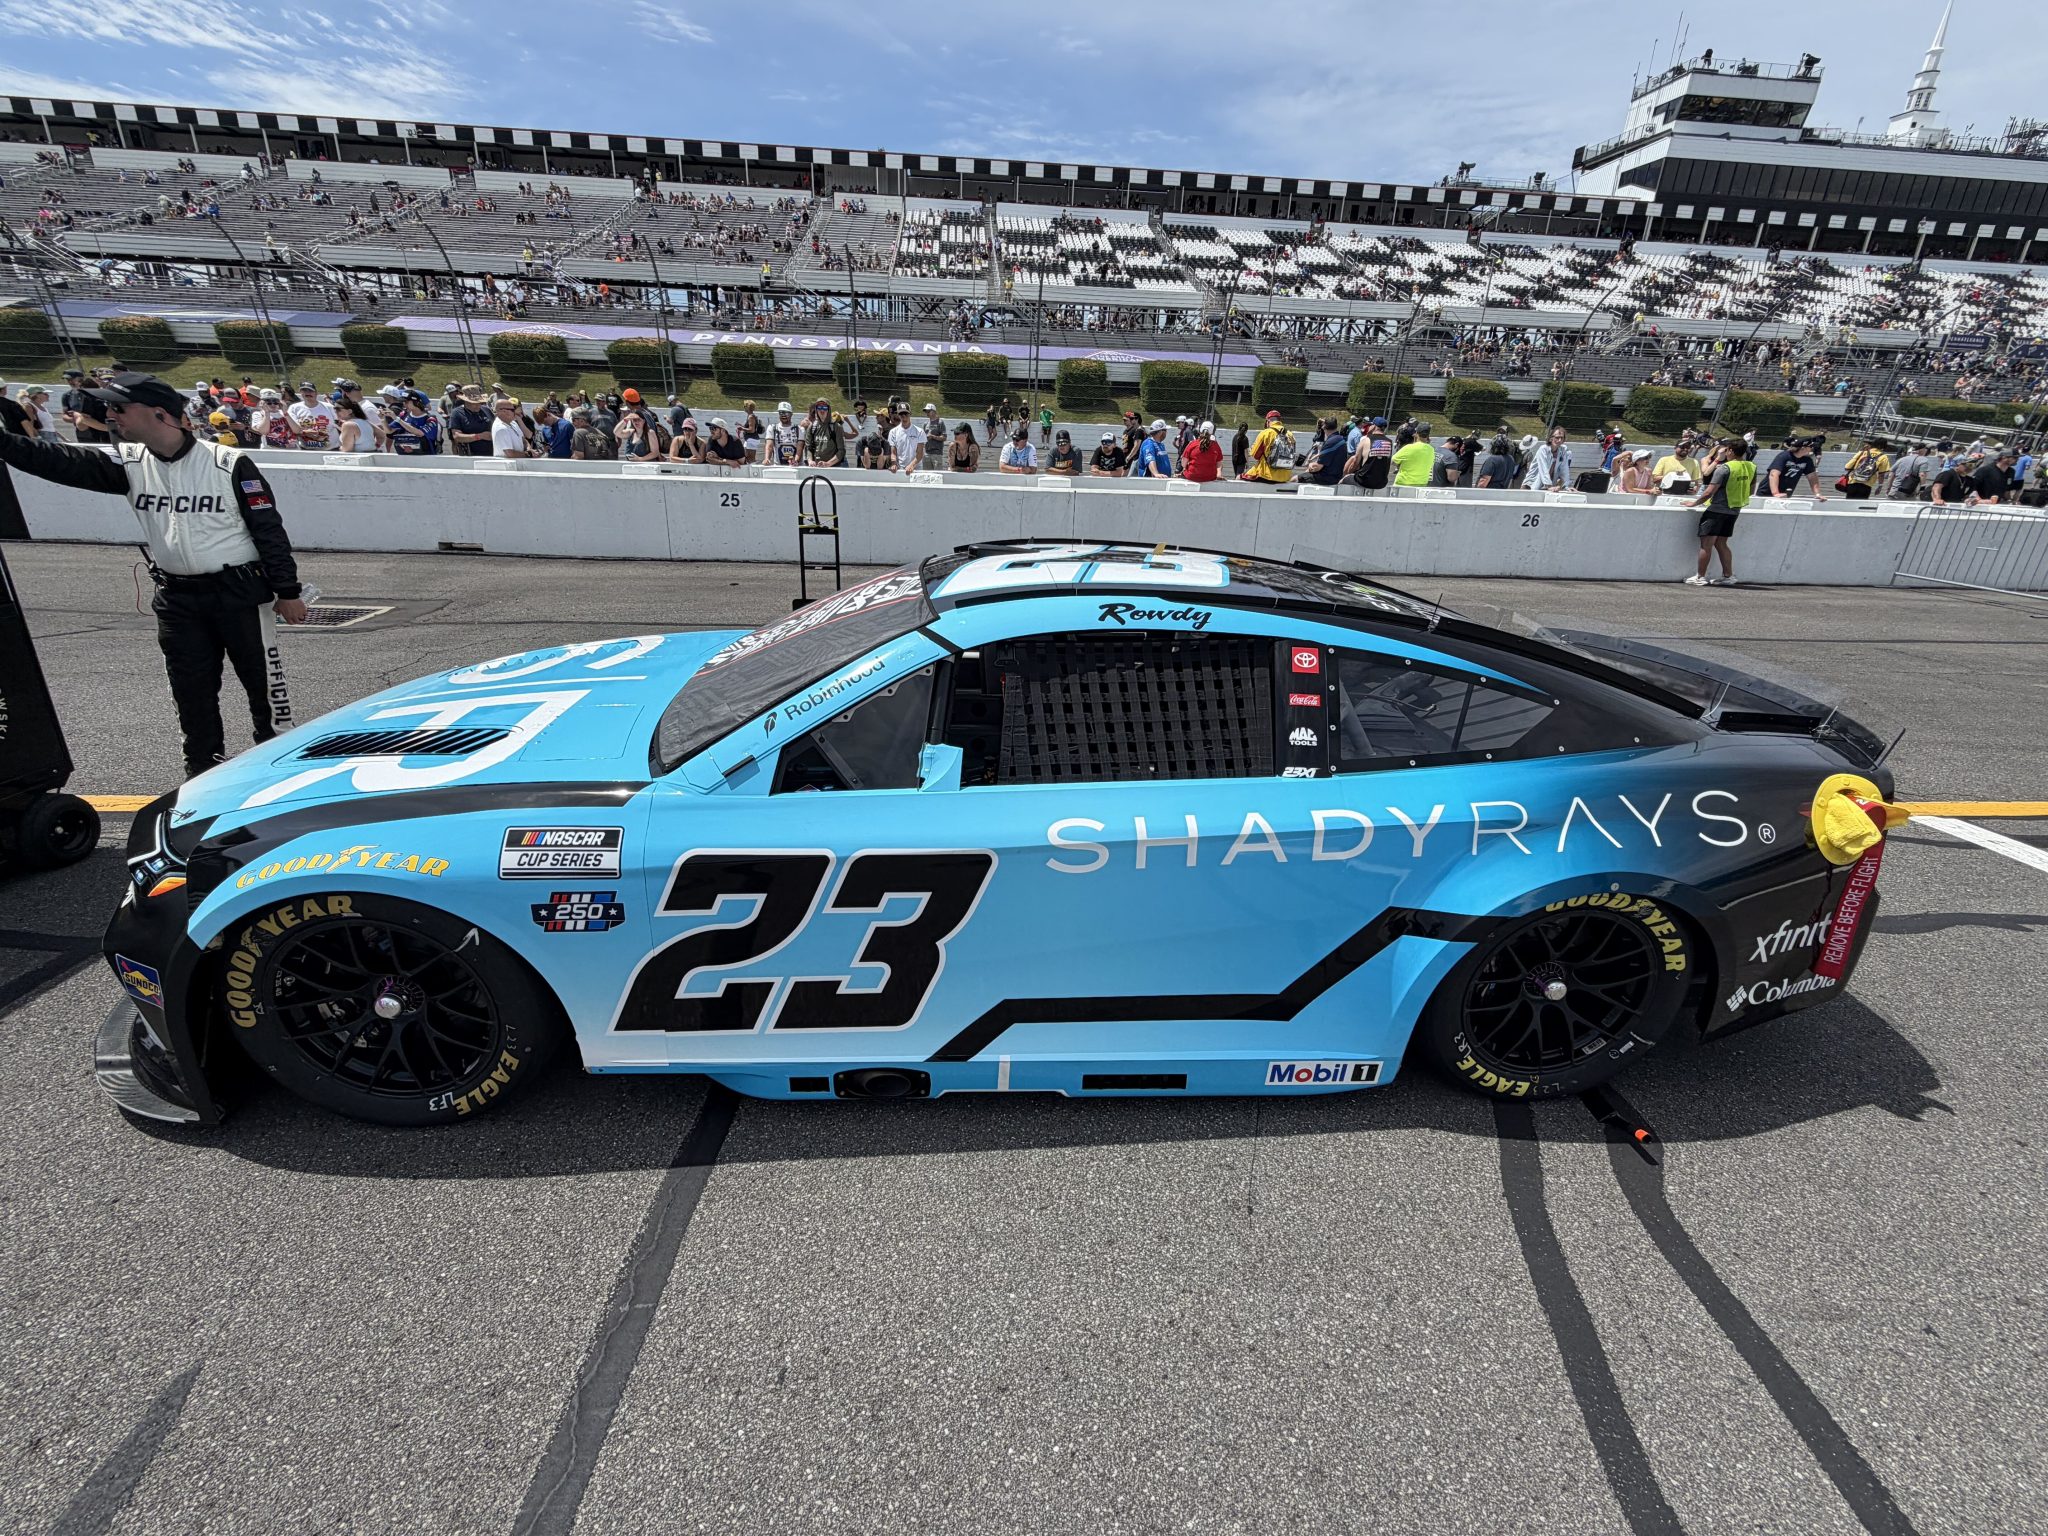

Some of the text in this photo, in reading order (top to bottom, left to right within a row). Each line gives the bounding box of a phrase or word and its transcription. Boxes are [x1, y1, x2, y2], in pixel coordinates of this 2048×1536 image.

[692, 333, 985, 353] PENNSYLVANIA
[135, 493, 226, 513] OFFICIAL
[720, 493, 741, 507] 25
[1521, 513, 1540, 527] 26
[1098, 603, 1213, 629] Rowdy
[267, 647, 292, 725] OFFICIAL
[784, 656, 886, 721] Robinhood
[1288, 727, 1318, 741] MAC
[1282, 767, 1321, 778] 23XI
[541, 831, 606, 846] NASCAR
[517, 853, 604, 867] CUP SERIES
[554, 903, 604, 920] 250
[1823, 857, 1879, 965] REMOVE BEFORE FLIGHT
[606, 848, 998, 1035] 23
[1749, 912, 1832, 963] xfinit
[124, 973, 160, 994] SUNOCO
[1748, 974, 1836, 1005] Columbia
[453, 1050, 520, 1115] EAGLE
[1269, 1064, 1370, 1082] Mobil 1
[1456, 1055, 1530, 1096] EAGLE
